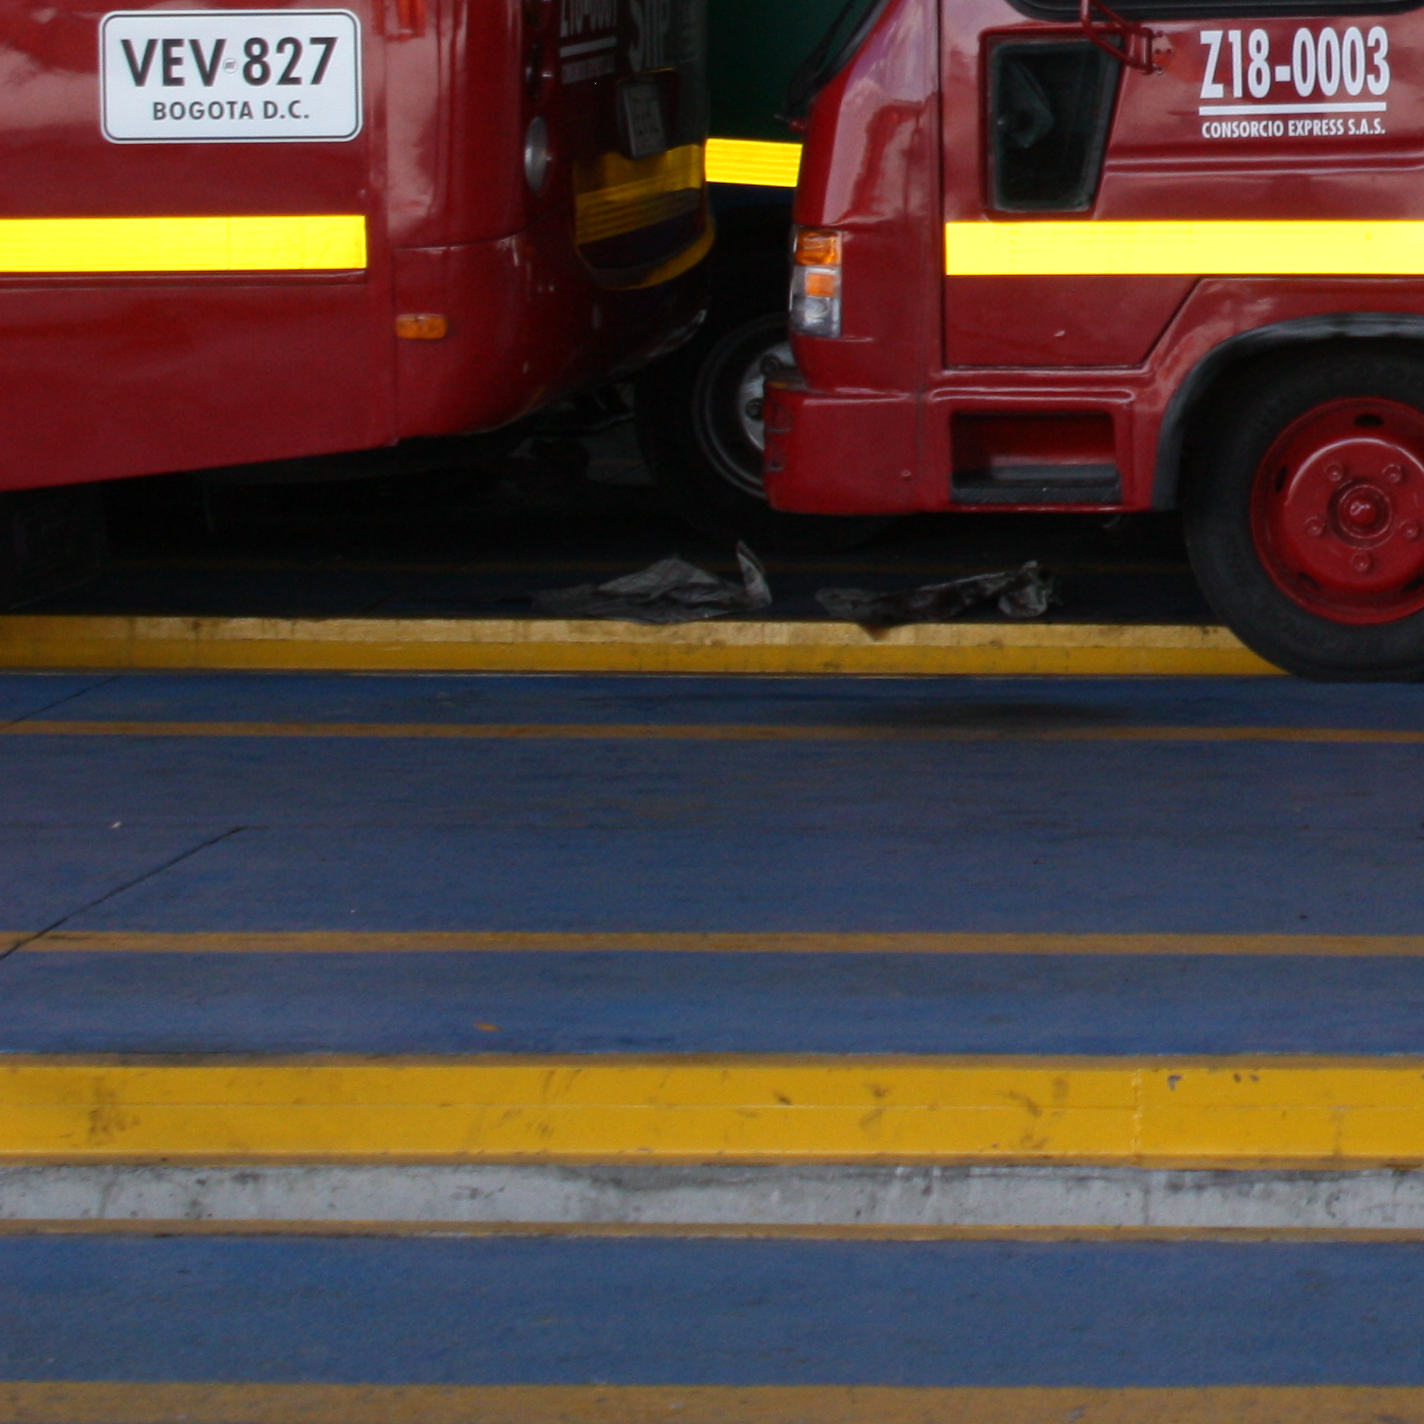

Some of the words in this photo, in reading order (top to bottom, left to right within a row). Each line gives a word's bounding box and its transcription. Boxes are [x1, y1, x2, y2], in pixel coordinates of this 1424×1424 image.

[120, 38, 228, 87] VEV
[242, 36, 340, 86] 827
[1200, 26, 1391, 99] Z18-0003
[152, 100, 254, 122] BOGOTA
[262, 99, 311, 120] D.C.
[1202, 120, 1285, 139] CONSORCIO
[1288, 119, 1345, 137] EXPRESS
[1347, 117, 1387, 136] S.A.S.
